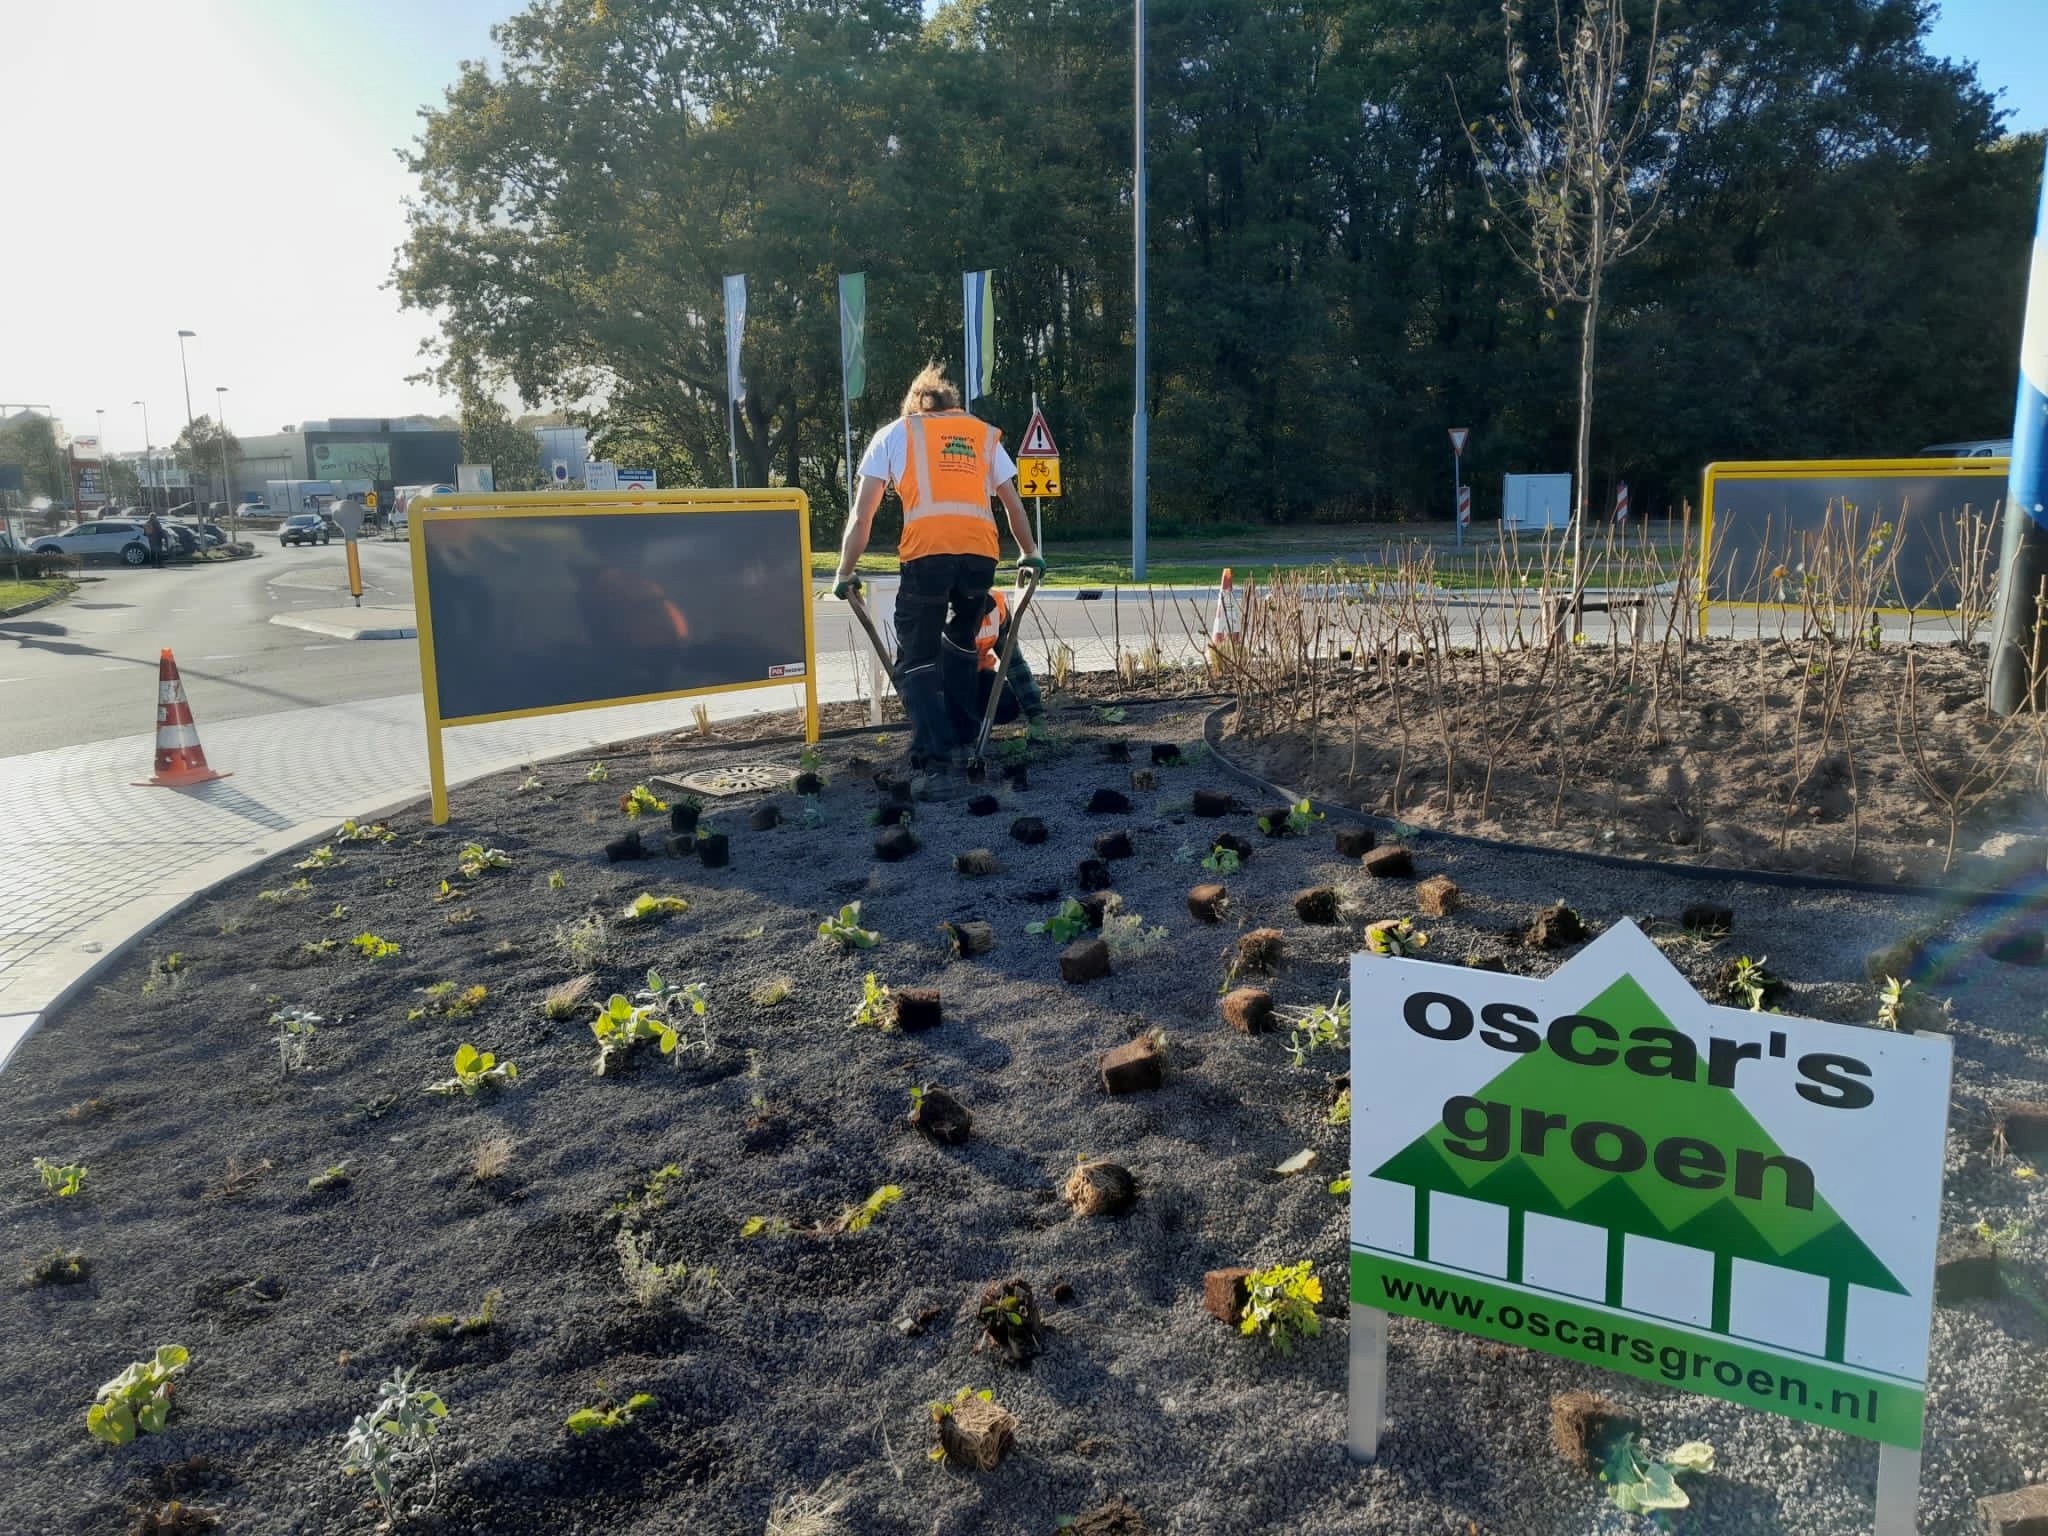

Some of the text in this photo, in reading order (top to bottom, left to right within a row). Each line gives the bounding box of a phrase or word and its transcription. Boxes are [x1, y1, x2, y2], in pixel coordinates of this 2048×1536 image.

[1402, 991, 1875, 1110] oscar's
[1441, 1095, 1816, 1211] groen
[1382, 1275, 1878, 1423] www.oscarsgroen.nl
